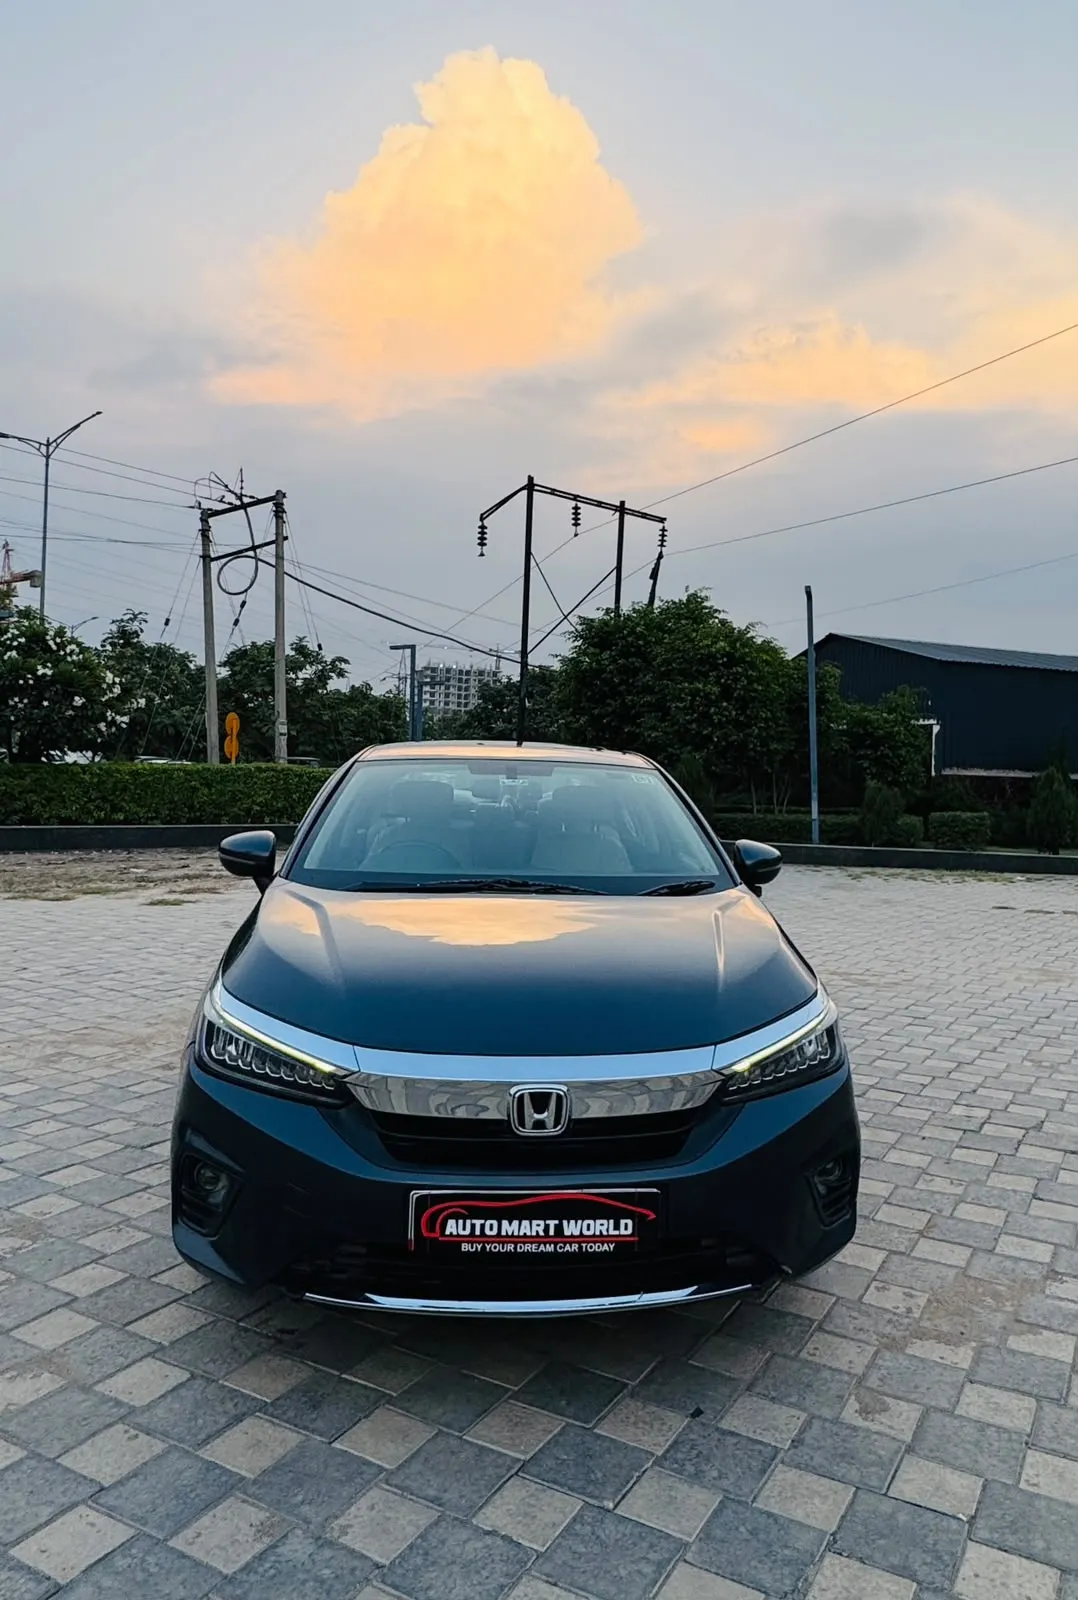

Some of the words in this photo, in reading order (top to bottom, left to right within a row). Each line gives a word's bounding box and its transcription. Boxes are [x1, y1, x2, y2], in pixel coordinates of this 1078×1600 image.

[444, 1218, 499, 1236] AUTO
[500, 1218, 559, 1236] MART
[562, 1218, 633, 1236] WORLD
[461, 1242, 482, 1252] BUY
[484, 1242, 515, 1252] YOUR
[517, 1242, 555, 1252] DREAM
[556, 1242, 578, 1252] CAR
[581, 1242, 616, 1252] TODAY
